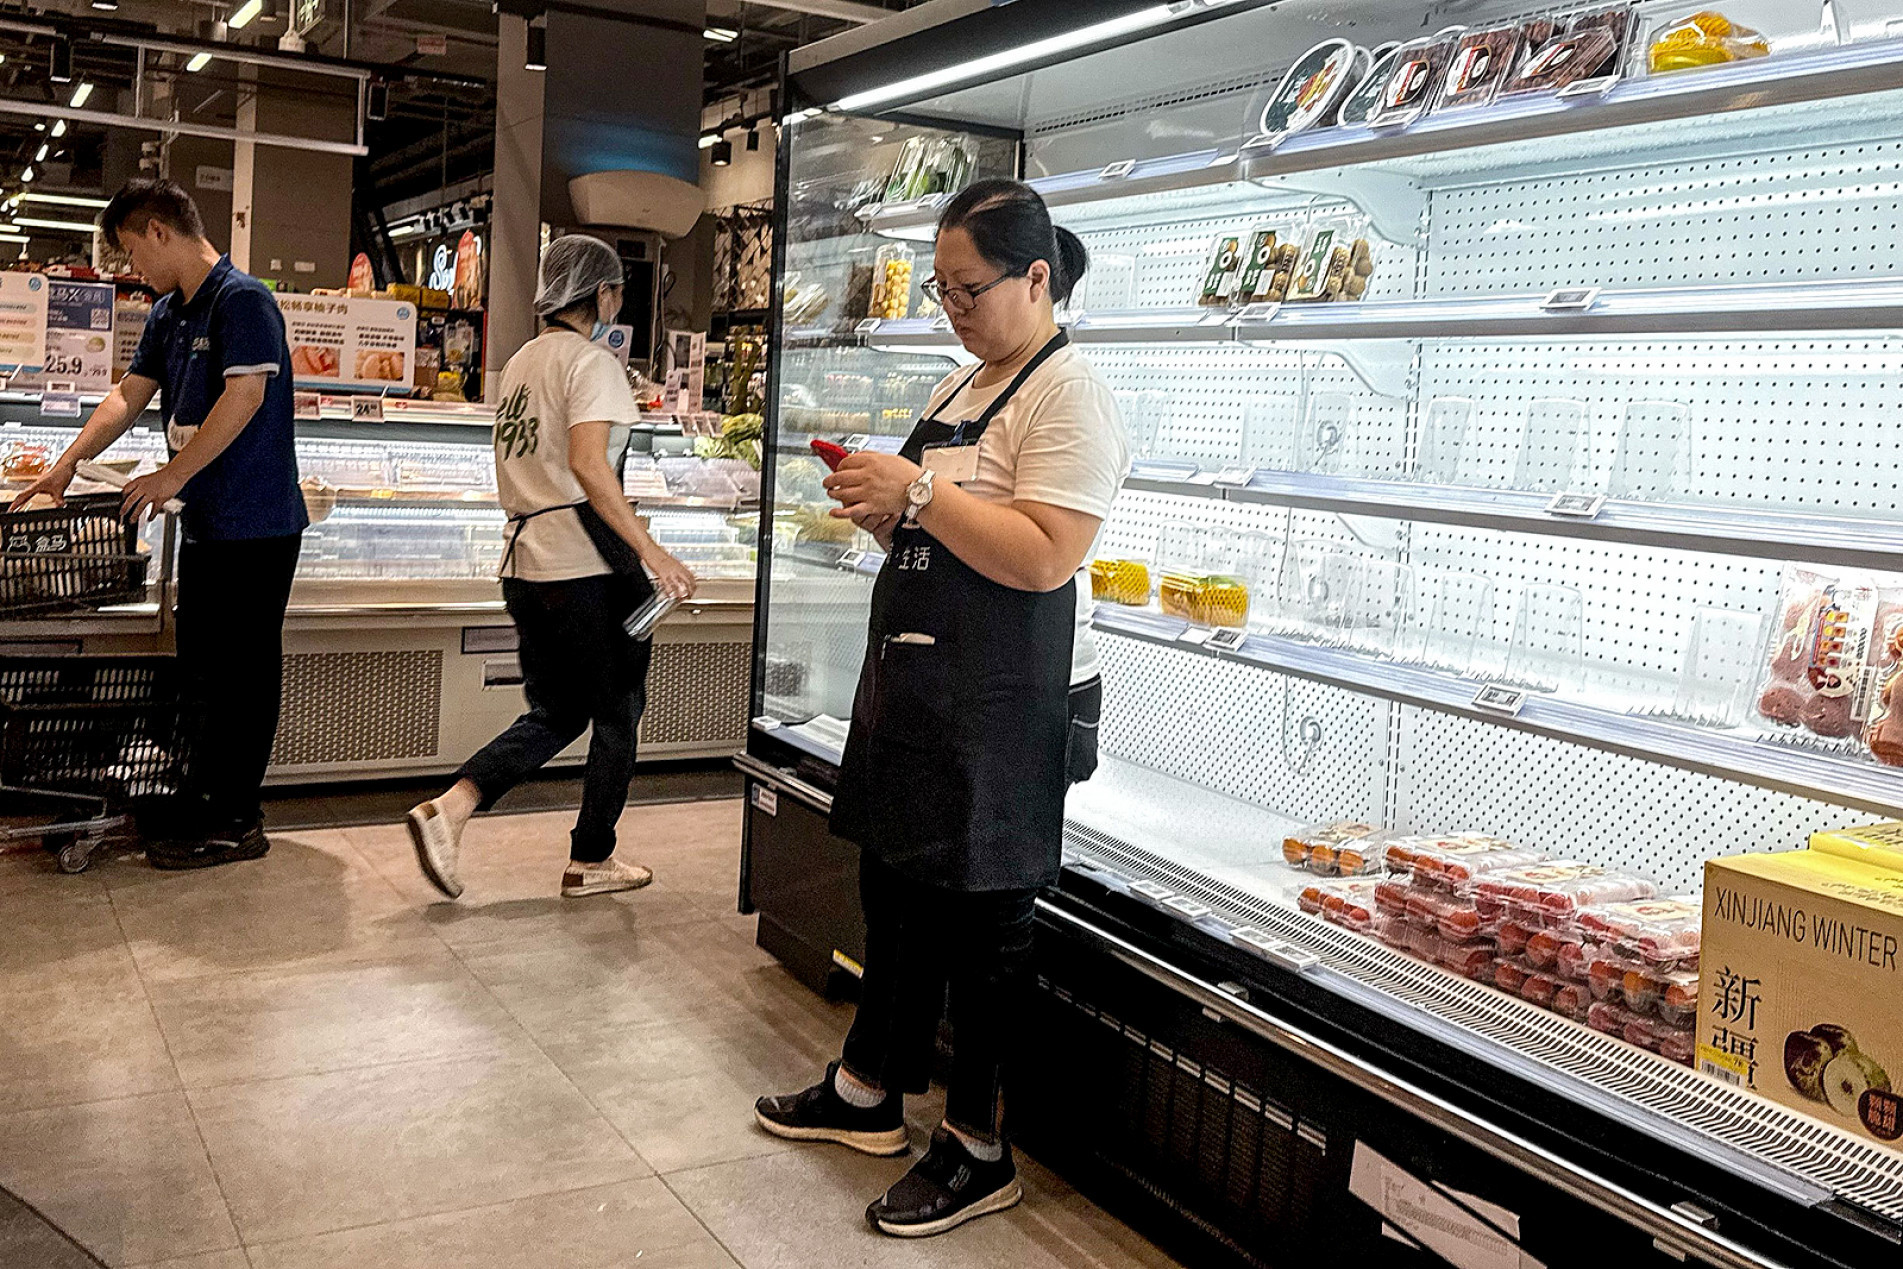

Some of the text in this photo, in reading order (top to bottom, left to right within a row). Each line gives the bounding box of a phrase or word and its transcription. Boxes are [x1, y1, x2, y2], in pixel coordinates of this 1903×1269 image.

[45, 355, 82, 376] 25.9
[1714, 886, 1807, 943] XINJIANG
[1813, 914, 1899, 971] WINTER
